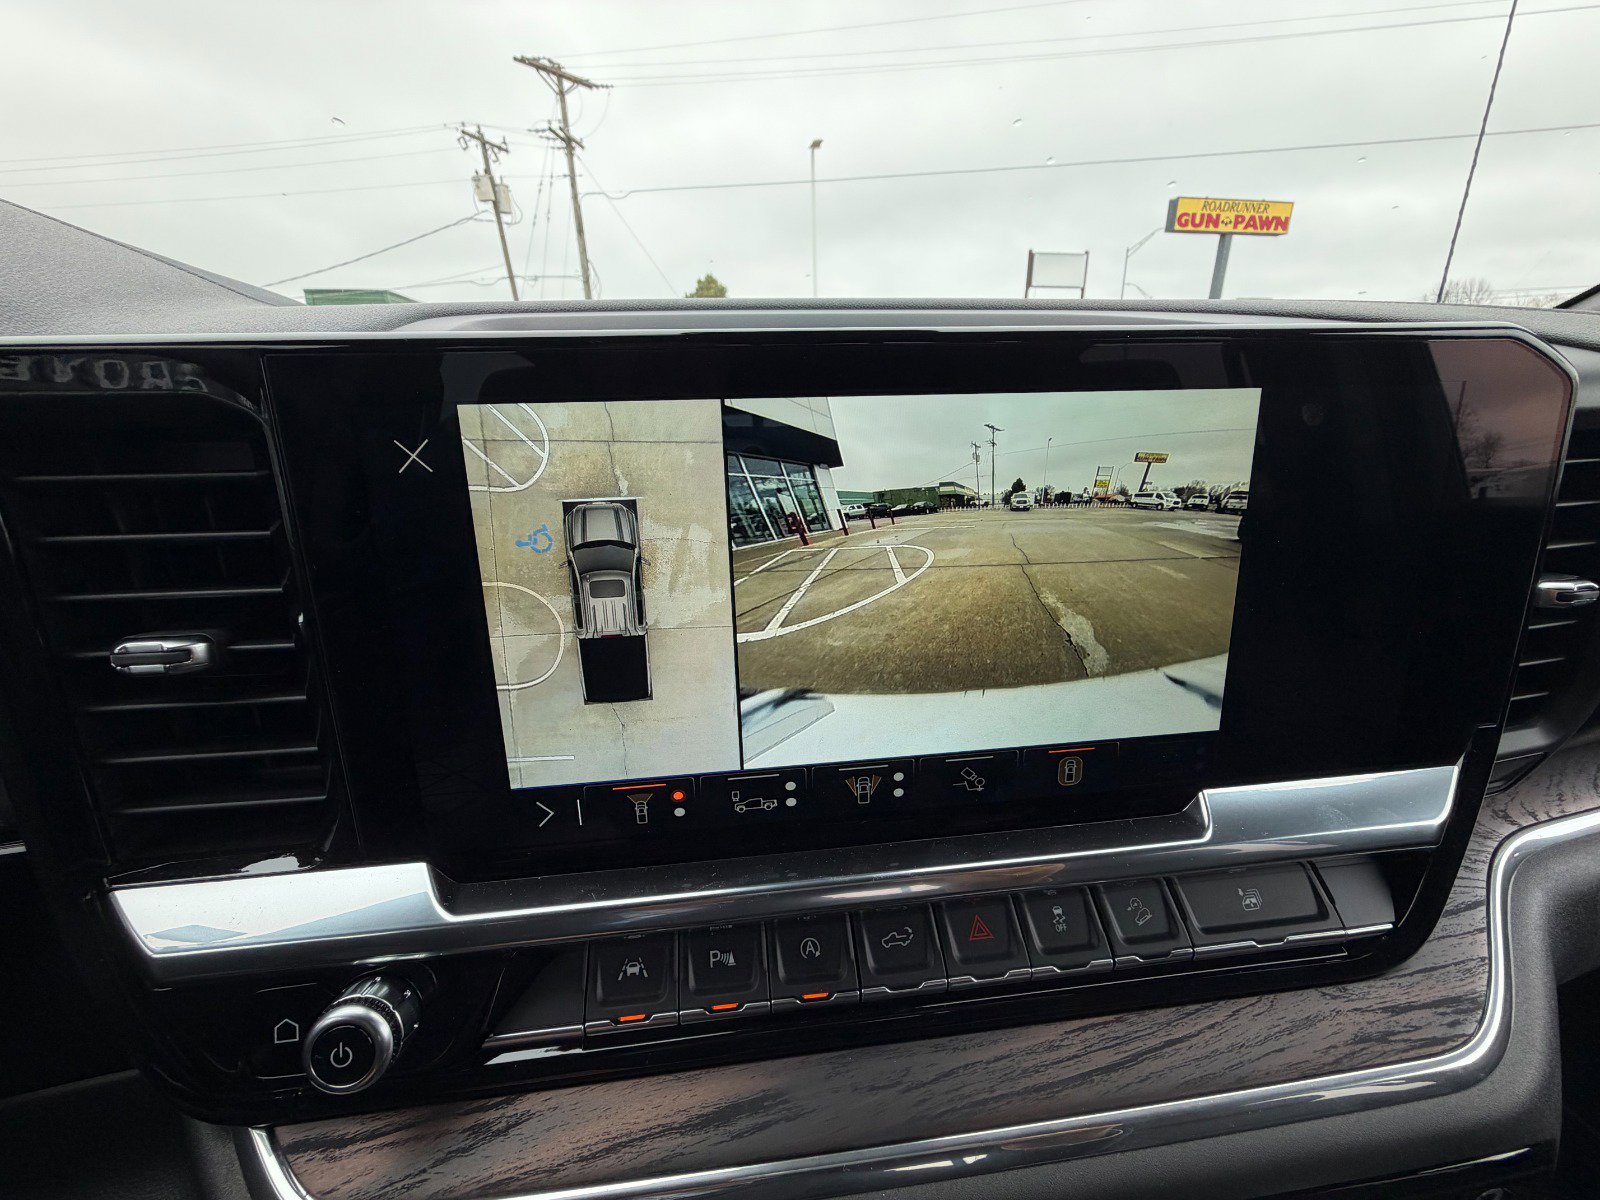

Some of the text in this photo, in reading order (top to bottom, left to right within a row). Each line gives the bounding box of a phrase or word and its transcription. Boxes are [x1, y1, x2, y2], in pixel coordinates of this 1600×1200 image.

[1202, 200, 1270, 214] ROADRUNNER
[1176, 212, 1290, 231] GUN PAWN
[1055, 923, 1068, 933] OFF
